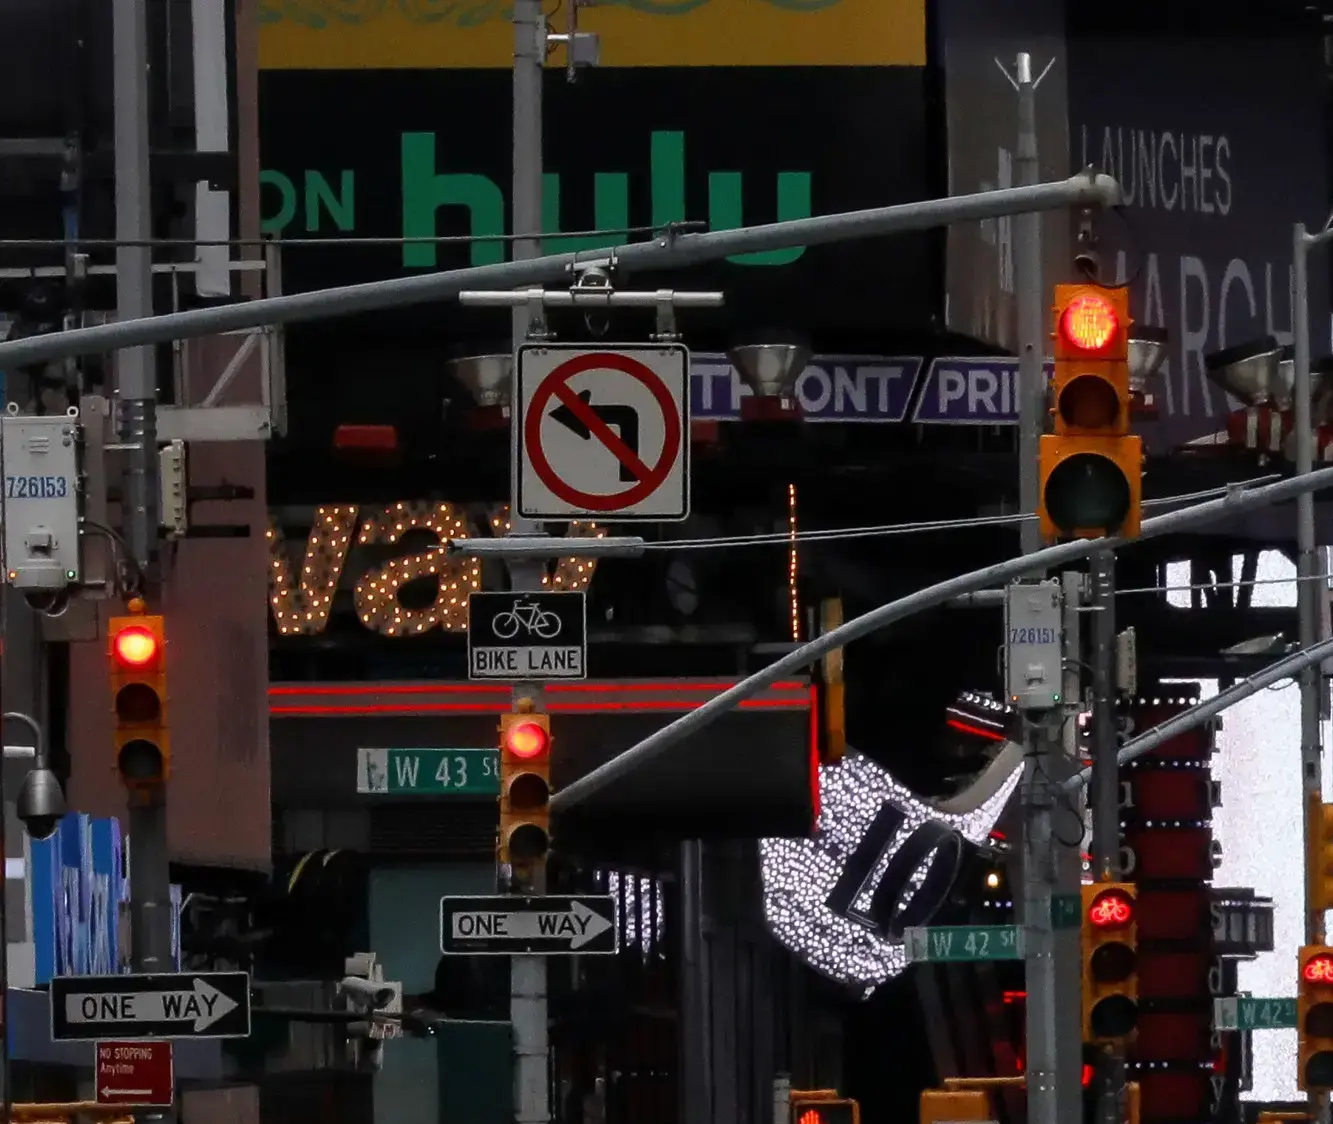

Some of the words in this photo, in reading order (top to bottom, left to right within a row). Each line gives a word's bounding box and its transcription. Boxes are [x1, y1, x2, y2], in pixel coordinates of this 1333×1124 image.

[401, 130, 812, 267] hulu
[1113, 248, 1298, 418] ARCH
[6, 476, 67, 498] 726153
[476, 650, 518, 671] BIKE
[527, 650, 579, 671] LANE
[394, 755, 420, 787] W
[434, 755, 468, 788] 43
[457, 914, 508, 936] ONE
[538, 914, 592, 936] WAY
[932, 931, 953, 957] W
[964, 931, 990, 957] 42
[1000, 930, 1016, 947] St
[81, 996, 136, 1020] ONE
[161, 995, 219, 1018] WAY
[1241, 1003, 1257, 1026] W
[1259, 1004, 1283, 1027] 42
[99, 1047, 112, 1060] NO
[114, 1047, 153, 1061] STOPPING
[100, 1062, 136, 1077] Anytime
